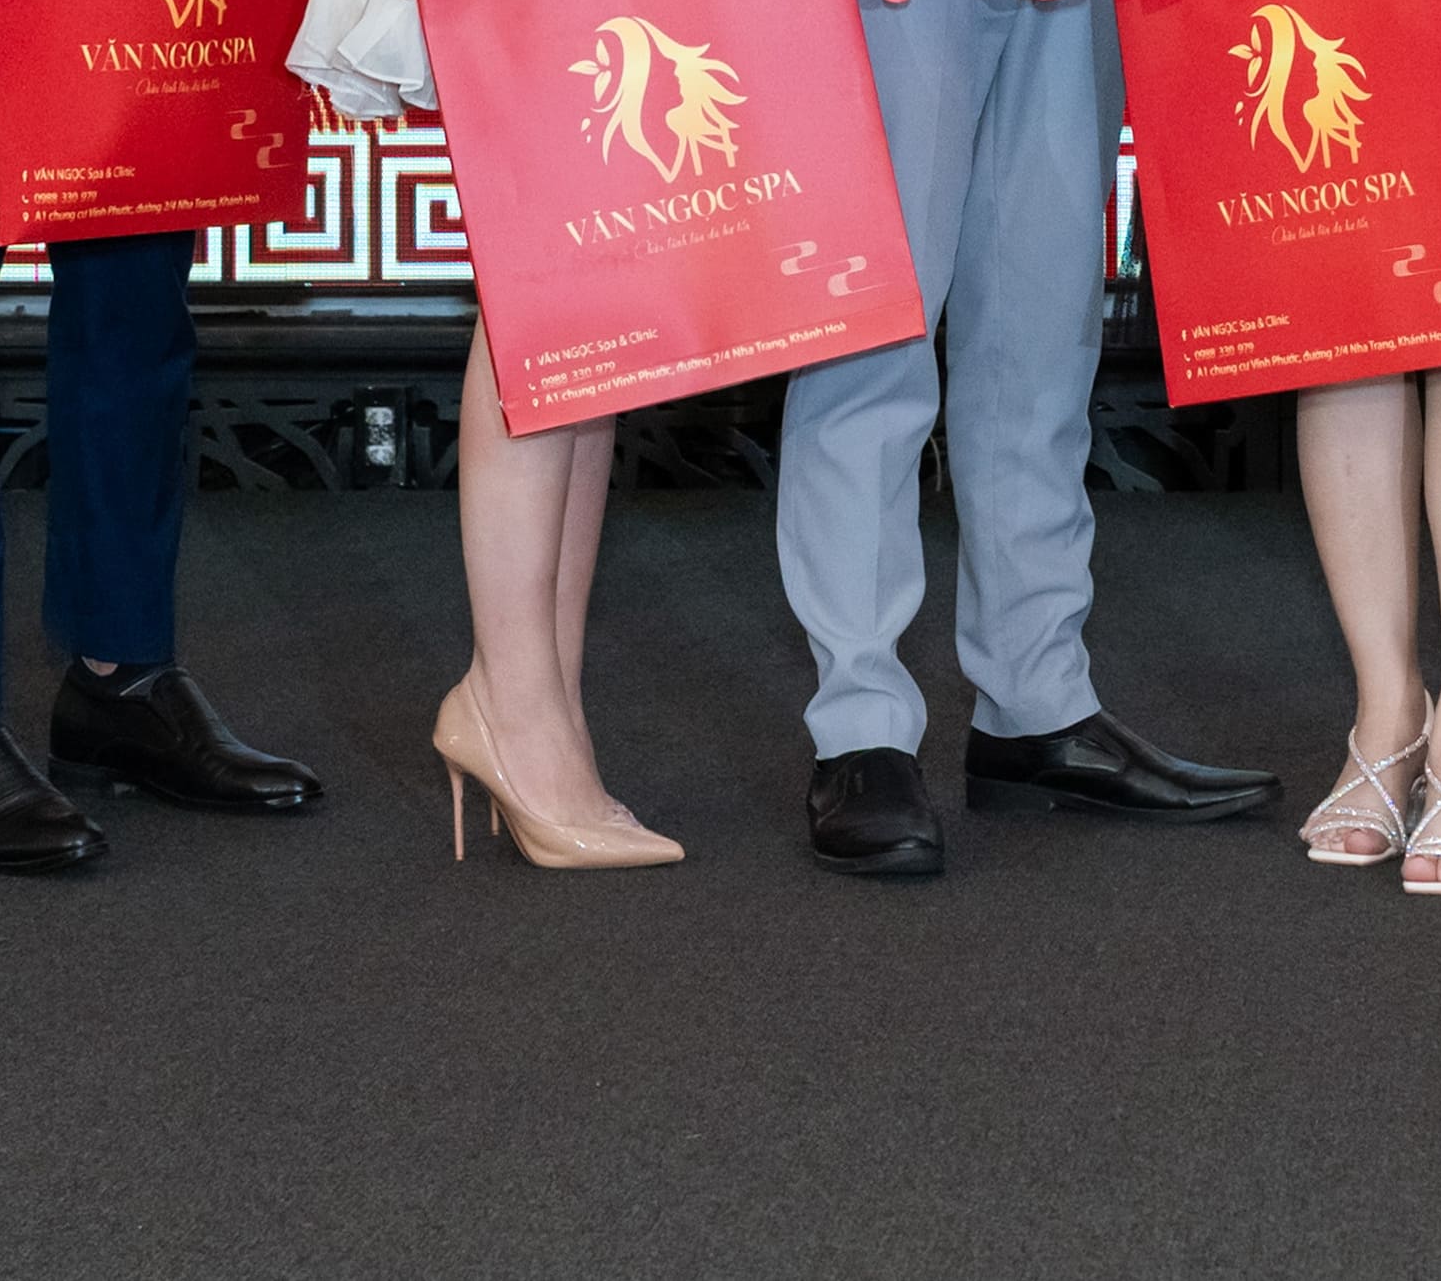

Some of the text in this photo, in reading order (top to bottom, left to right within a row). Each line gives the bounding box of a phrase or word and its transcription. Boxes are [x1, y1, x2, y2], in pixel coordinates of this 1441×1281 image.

[80, 36, 255, 73] VĂN NGỌC SPA
[86, 166, 104, 181] Spa
[104, 166, 112, 178] &
[565, 207, 635, 245] VĂN
[643, 182, 736, 224] NGỌC
[743, 169, 802, 204] SPA
[1217, 170, 1414, 226] VĂN NGỌC SPA
[596, 338, 617, 352] Spa
[618, 334, 628, 346] &
[628, 327, 658, 344] Clinic
[1238, 319, 1257, 332] Spa
[1256, 316, 1265, 329] &
[1264, 313, 1290, 328] Clinic
[545, 391, 558, 404] A1
[560, 384, 596, 401] chung
[712, 349, 731, 364] 2/4
[731, 345, 754, 358] Nha
